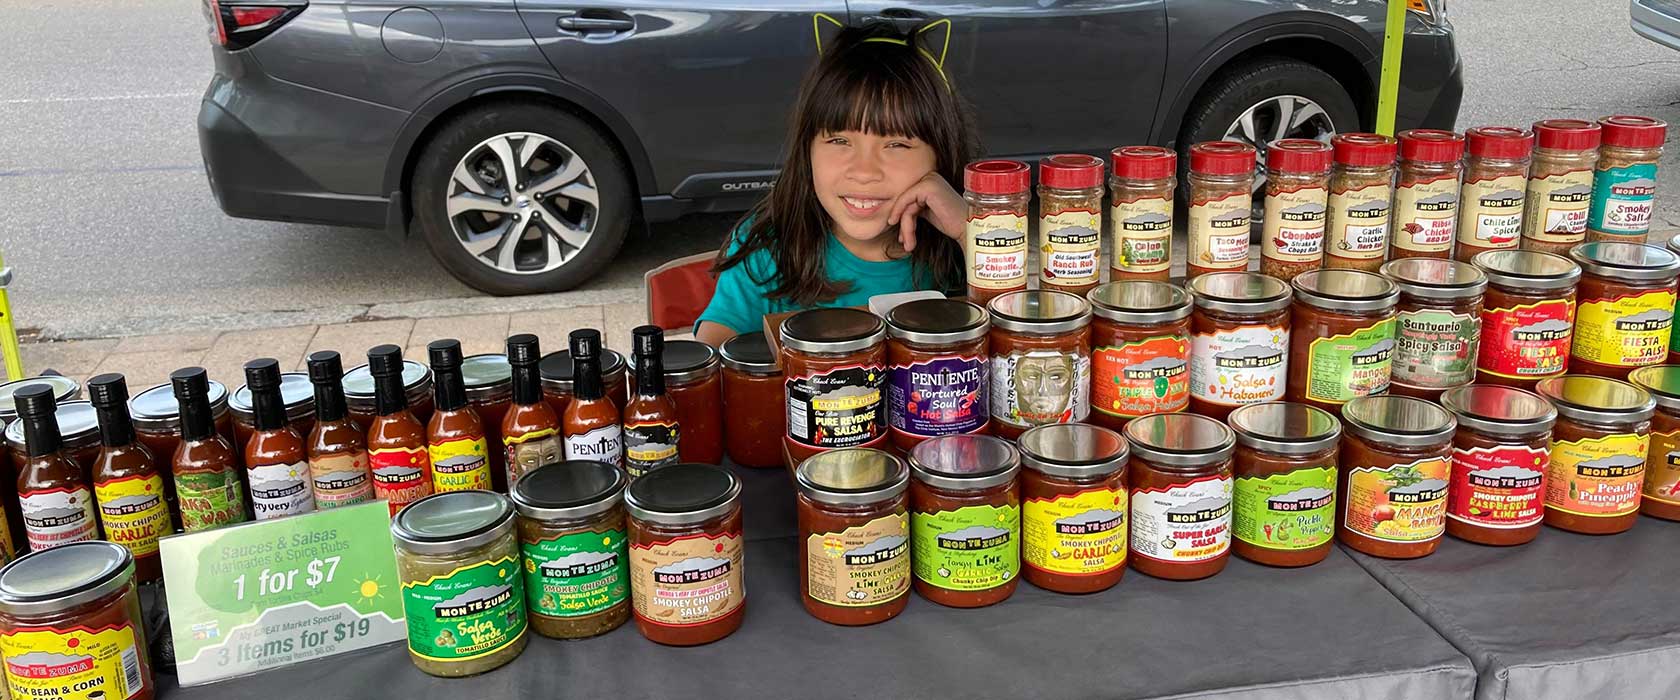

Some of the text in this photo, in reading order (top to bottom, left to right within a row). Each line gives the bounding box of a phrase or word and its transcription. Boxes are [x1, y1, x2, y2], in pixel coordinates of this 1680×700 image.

[722, 181, 777, 190] OUTBAC
[1616, 205, 1650, 214] Smokey
[1483, 217, 1520, 226] Chile Lim
[1624, 213, 1645, 221] Salt
[1282, 231, 1323, 240] Chophous
[1362, 227, 1383, 235] Garlic
[1493, 226, 1514, 235] Spice
[1135, 242, 1161, 251] Cajun
[985, 255, 1017, 264] Smokey
[1052, 260, 1077, 268] Ranch
[985, 262, 1018, 272] Chipotle
[1404, 318, 1461, 331] Santuario
[1399, 337, 1461, 352] Spicy Salsa
[1623, 336, 1659, 347] FIESTA
[1521, 346, 1557, 358] FIESTA
[1640, 345, 1665, 357] SALSA
[1537, 356, 1564, 368] SALSA
[911, 367, 978, 386] PENITENTE
[1233, 374, 1266, 389] Salsa
[919, 385, 968, 399] Tortured
[1119, 386, 1153, 398] TRIPLE
[1219, 385, 1275, 401] Habanero
[932, 398, 956, 409] Soul
[1121, 397, 1152, 411] Salsa
[815, 410, 876, 426] PURE REVENGE
[920, 408, 971, 419] Hot Salsa
[834, 425, 863, 436] SALSA
[572, 436, 620, 456] PENITEN
[439, 475, 471, 486] GARLIC
[1598, 481, 1638, 493] Peachy
[1473, 492, 1537, 502] SMOKEY CHIPOTLE
[1580, 490, 1637, 503] Pineapple
[269, 500, 290, 512] Very
[1397, 500, 1445, 520] MANGO
[1469, 498, 1529, 511] RASPBERRY
[1493, 510, 1517, 519] LIME
[112, 524, 156, 542] GARLIC
[1172, 522, 1228, 540] SUPER GARLIC
[1383, 528, 1408, 537] Salsa
[221, 528, 338, 561] Sauces & Salsas
[1061, 539, 1092, 548] SMOKEY
[1191, 536, 1217, 548] SALSA
[1073, 543, 1112, 560] GARLIC
[209, 540, 350, 576] Marinades & Spice Rubs
[976, 554, 1001, 567] LIME
[1083, 558, 1105, 566] SALSA
[233, 574, 246, 601] 1
[258, 567, 299, 596] for
[305, 555, 342, 589] $7
[849, 569, 882, 579] SMOKEY
[956, 567, 991, 577] GARLIC
[543, 574, 618, 593] SMOKEY CHIPOTLE
[856, 578, 881, 589] LIME
[559, 586, 609, 600] TOMATILLO SAUCE
[873, 584, 895, 596] SALSA
[559, 598, 586, 610] Salsa
[587, 593, 610, 608] Verde
[653, 589, 732, 608] SMOKEY CHIPOTLE
[680, 605, 709, 617] SALSA
[281, 619, 311, 632] Market
[312, 611, 342, 627] Special
[457, 619, 494, 636] Salsa
[216, 616, 371, 668] 3 Items for $19
[470, 628, 502, 645] Verde
[86, 642, 101, 651] MILD
[456, 635, 507, 654] TOMATILLO SAUCE
[293, 648, 314, 662] Items
[30, 686, 59, 697] BEAN
[61, 685, 71, 694] &
[73, 675, 105, 693] CORN
